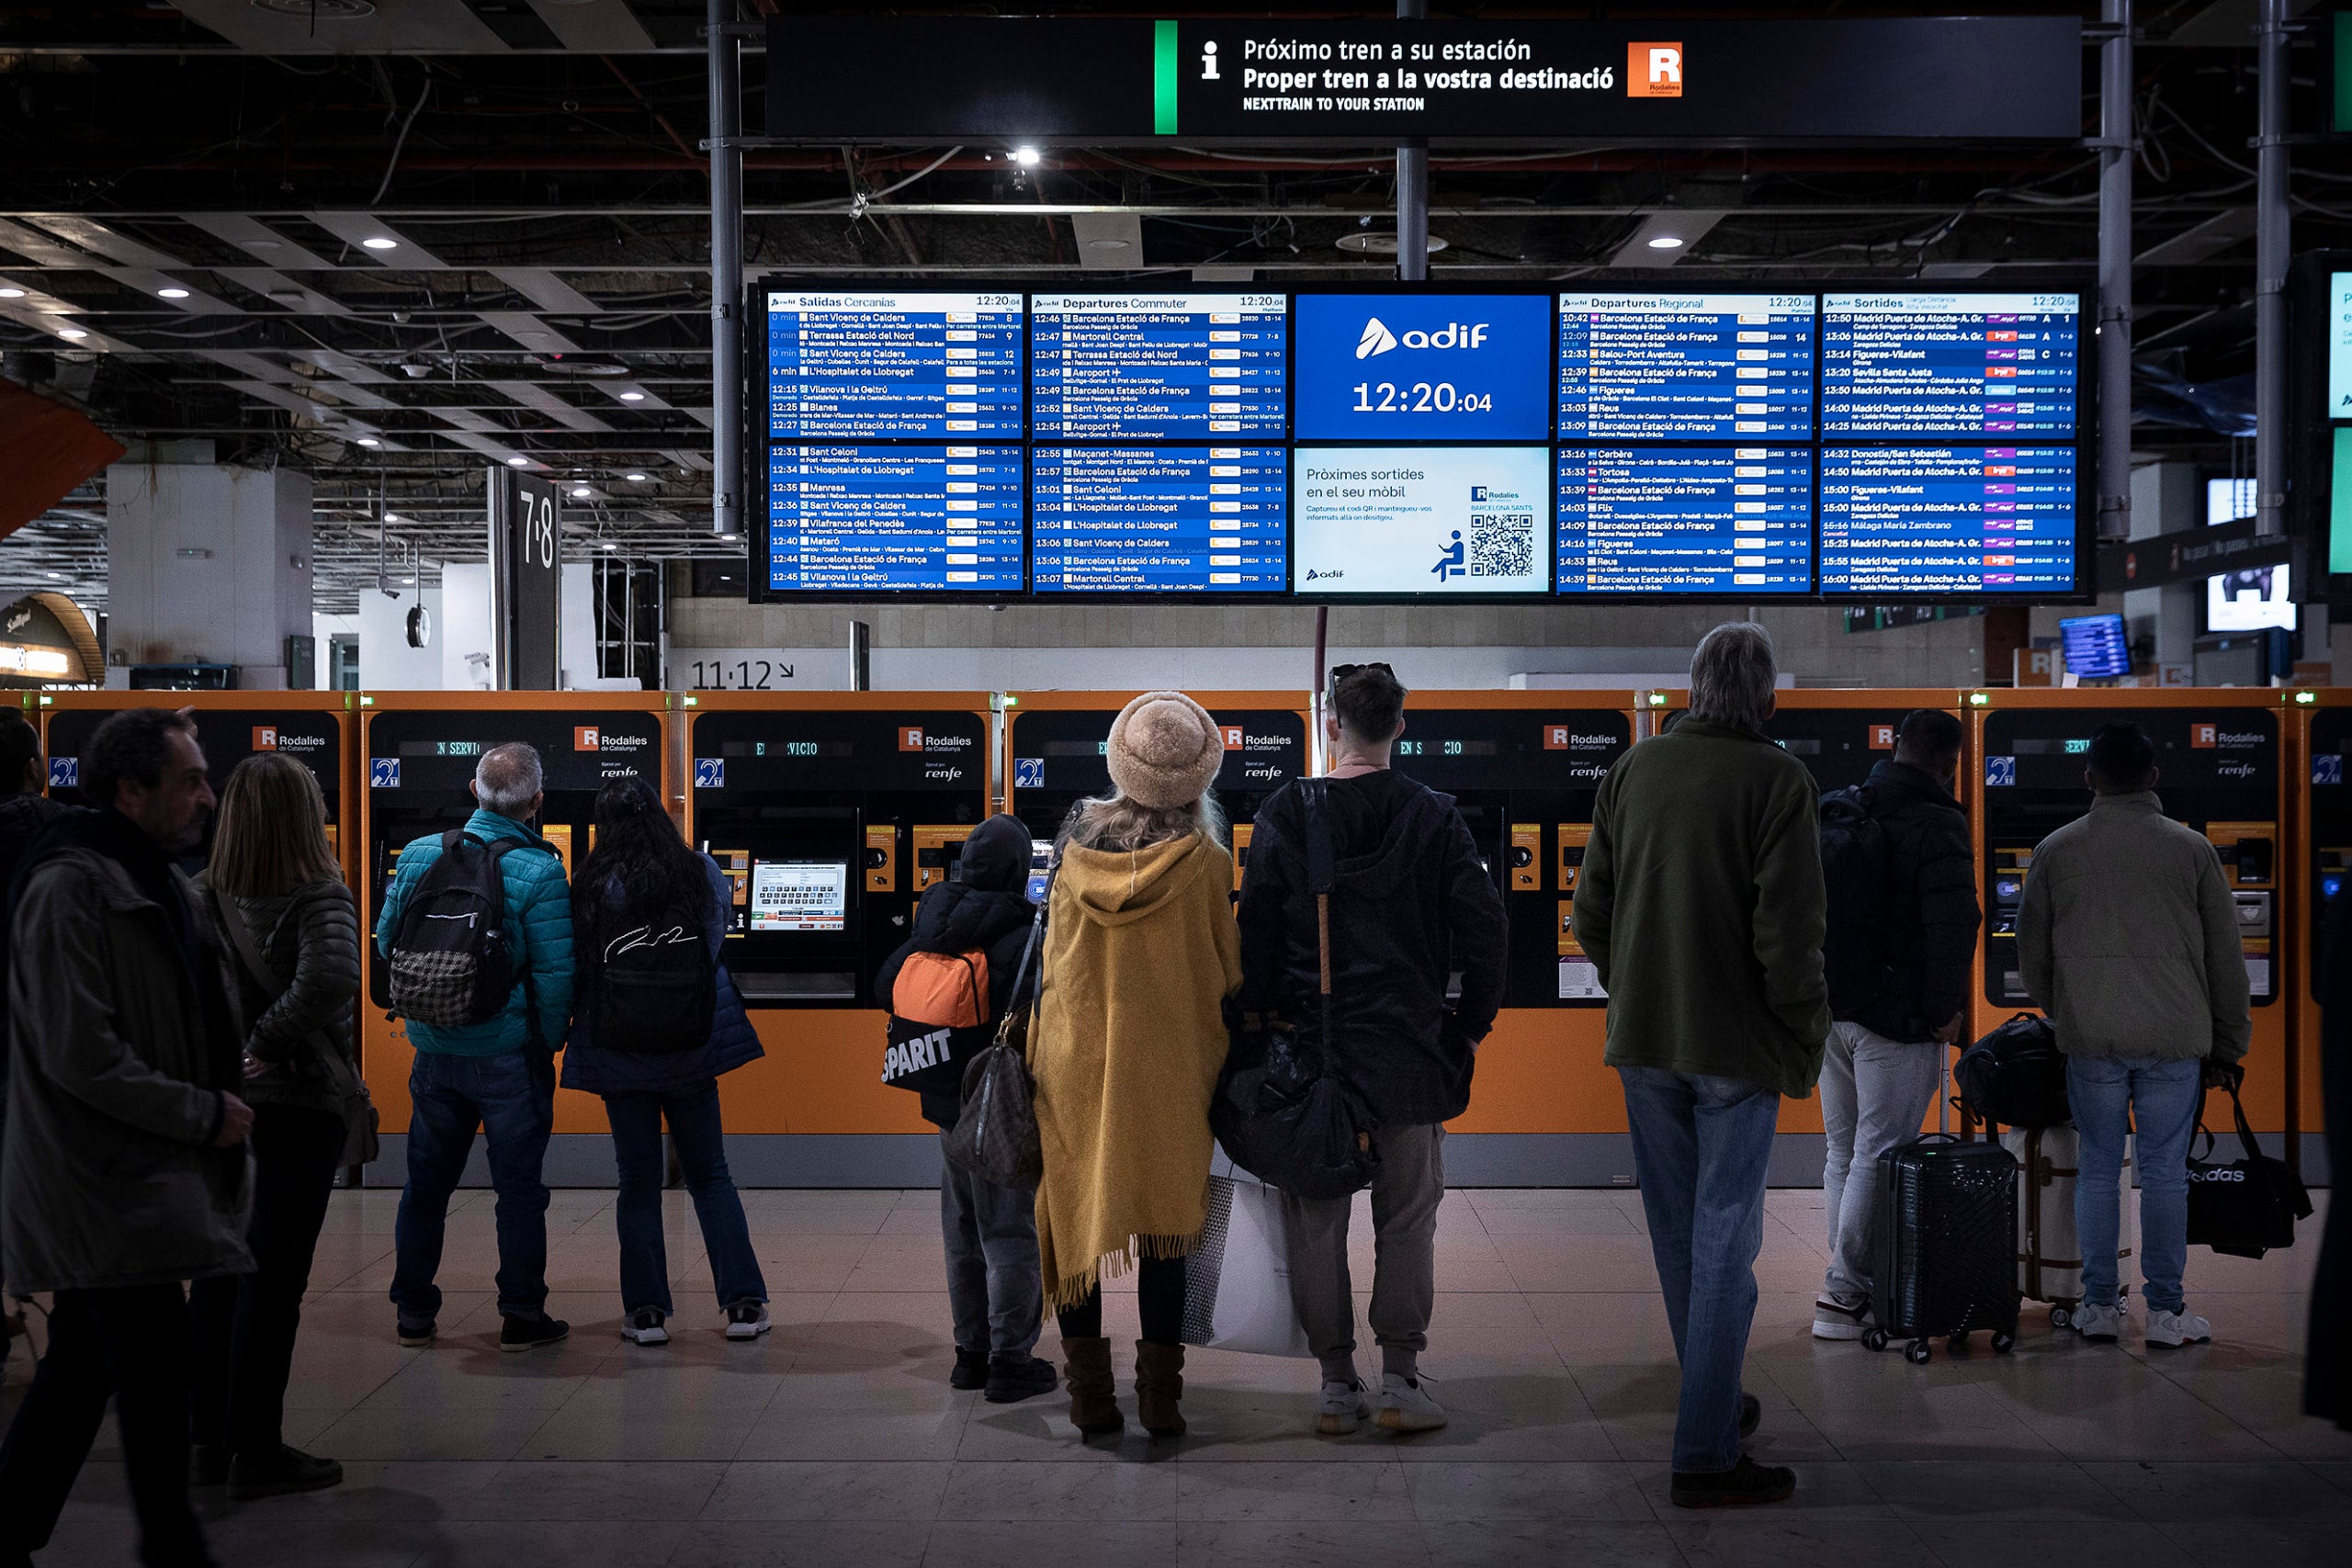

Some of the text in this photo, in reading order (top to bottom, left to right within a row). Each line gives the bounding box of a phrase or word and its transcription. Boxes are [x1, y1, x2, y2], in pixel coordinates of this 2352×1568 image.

[1245, 39, 1530, 60] Próximo tren a su estación
[1650, 49, 1680, 82] R
[1245, 67, 1613, 92] Proper tren a la vostra destinació
[1317, 97, 1332, 110] TO
[1336, 97, 1370, 110] YOUR
[1374, 97, 1424, 110] STATION
[800, 298, 841, 306] Salidas
[844, 298, 895, 307] Cercanías
[1064, 299, 1127, 310] Departures
[1131, 299, 1186, 308] Commuter
[1592, 299, 1656, 309] Departures
[1660, 299, 1702, 310] Regional
[1855, 299, 1903, 307] Sortides
[809, 313, 828, 321] Sant
[830, 313, 857, 323] Vicenç
[860, 313, 871, 321] de
[1826, 314, 1851, 322] 12:50
[1854, 314, 1883, 322] Madrid
[1885, 314, 1913, 322] Puerta
[1914, 314, 1926, 322] de
[809, 332, 914, 340] Terrassa Estació del Nord
[1073, 333, 1144, 341] Martorell Central
[1403, 323, 1488, 348] adif
[1600, 350, 1685, 359] Salou-Port Aventura
[1826, 350, 1850, 358] 13:14
[1853, 350, 1925, 360] Figueres-Vilafant
[1035, 368, 1059, 377] 12:49
[1073, 369, 1110, 378] Aeroport
[1826, 368, 1850, 377] 13:20
[1853, 368, 1932, 377] Sevilla Santa Justa
[1354, 383, 1492, 412] 12:20:04
[1073, 450, 1154, 459] Maçanet-Massanes
[1598, 450, 1633, 458] Cerbère
[1852, 449, 1951, 459] Donostia/San Sebastián
[1307, 468, 1424, 479] Pròximes sortides
[1327, 487, 1338, 497] el
[1369, 486, 1405, 497] mòbil
[1477, 489, 1487, 499] R
[1073, 503, 1123, 513] L'Hospitalet
[1137, 503, 1177, 513] Llobregat
[773, 519, 797, 527] 12:39
[810, 519, 853, 527] Vilafranca
[1851, 522, 1882, 531] Málaga
[262, 730, 276, 745] R
[583, 730, 598, 745] R
[908, 731, 922, 745] R
[1228, 730, 1242, 744] R
[1246, 736, 1291, 744] Rodalies
[1553, 729, 1567, 744] R
[1571, 735, 1616, 743] Rodalies
[1879, 729, 1893, 743] R
[2200, 728, 2215, 742] R
[2219, 733, 2265, 742] Rodalies
[280, 736, 324, 745] Rodalies
[602, 736, 647, 745] Rodalies
[926, 737, 971, 745] Rodalies
[1400, 742, 1411, 754] EN
[602, 766, 638, 777] renfe
[926, 767, 962, 781] renfe
[1246, 766, 1282, 780] renfe
[1571, 765, 1607, 779] renfe
[2218, 764, 2256, 777] renfe
